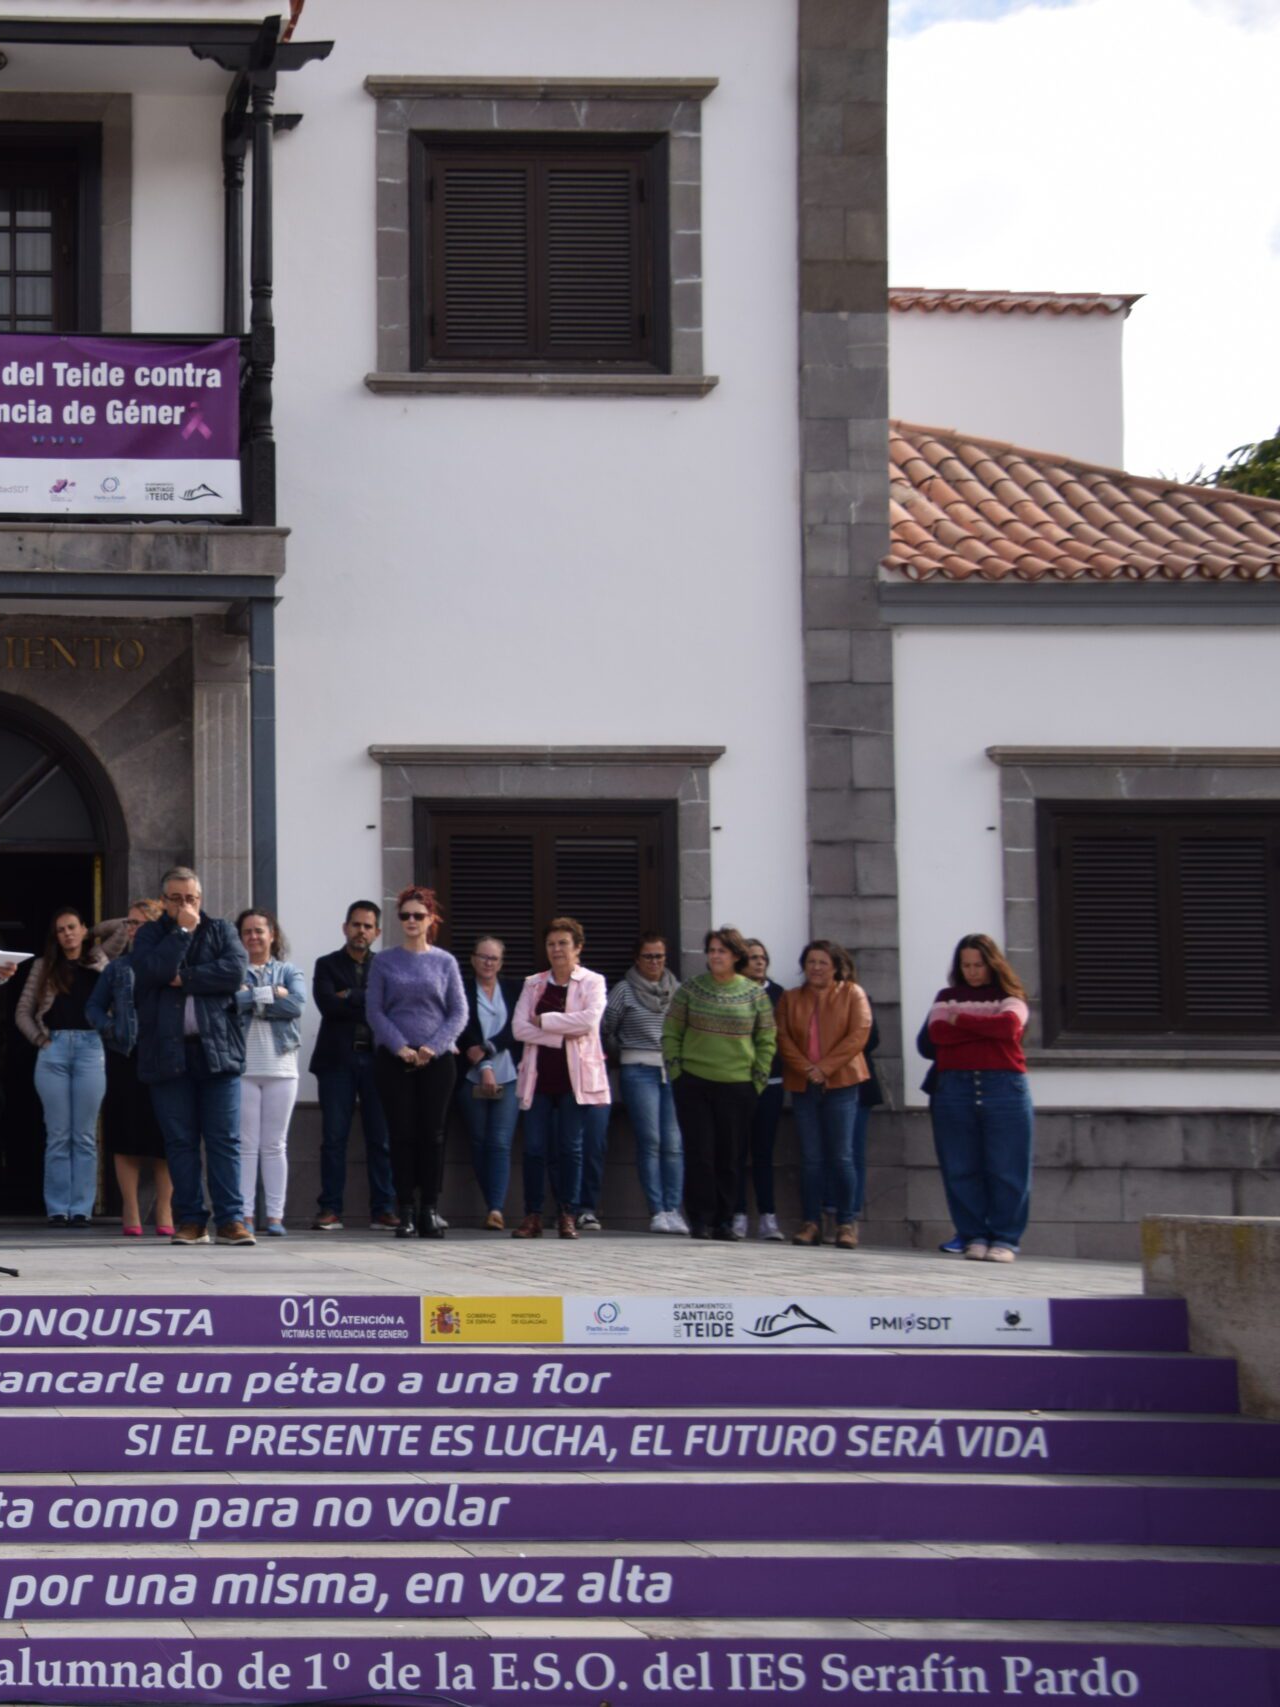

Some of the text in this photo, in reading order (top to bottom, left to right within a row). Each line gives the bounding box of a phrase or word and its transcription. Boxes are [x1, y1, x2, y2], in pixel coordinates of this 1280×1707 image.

[1, 361, 44, 386] del
[52, 361, 125, 387] Teide
[134, 362, 222, 388] contra
[62, 400, 96, 425] de
[150, 492, 175, 501] TEIDE
[279, 1298, 405, 1327] 016 ATENCIÓN A
[673, 1311, 734, 1321] SANTIAGO
[281, 1329, 314, 1338] VICTIMAS
[316, 1330, 326, 1338] DE
[328, 1330, 365, 1338] VIOLENCIA
[366, 1330, 376, 1338] DE
[674, 1322, 734, 1338] DEL TEIDE
[176, 1371, 232, 1394] un
[242, 1362, 386, 1403] pétalo
[397, 1372, 423, 1394] a
[436, 1372, 519, 1394] una
[532, 1362, 612, 1394] flor
[124, 1418, 1048, 1463] SI EL PRESENTE ES LUCHA, EL FUTURO SERÁ VIDA
[48, 1497, 179, 1529] como
[189, 1497, 299, 1541] para
[312, 1496, 373, 1528] no
[386, 1484, 511, 1527] volar
[3, 1574, 94, 1620] por
[105, 1573, 198, 1606] una
[212, 1561, 389, 1613] misma,
[405, 1572, 464, 1604] en
[479, 1572, 565, 1604] voz
[577, 1558, 673, 1604] alta
[237, 1650, 291, 1690] de
[304, 1652, 350, 1690] 1º
[367, 1651, 421, 1691] de
[434, 1651, 476, 1691] la
[489, 1652, 628, 1691] E.S.O.
[643, 1651, 714, 1691] del
[726, 1653, 806, 1691] IES
[821, 1652, 990, 1693] Serafín
[1001, 1656, 1139, 1697] Pardo
